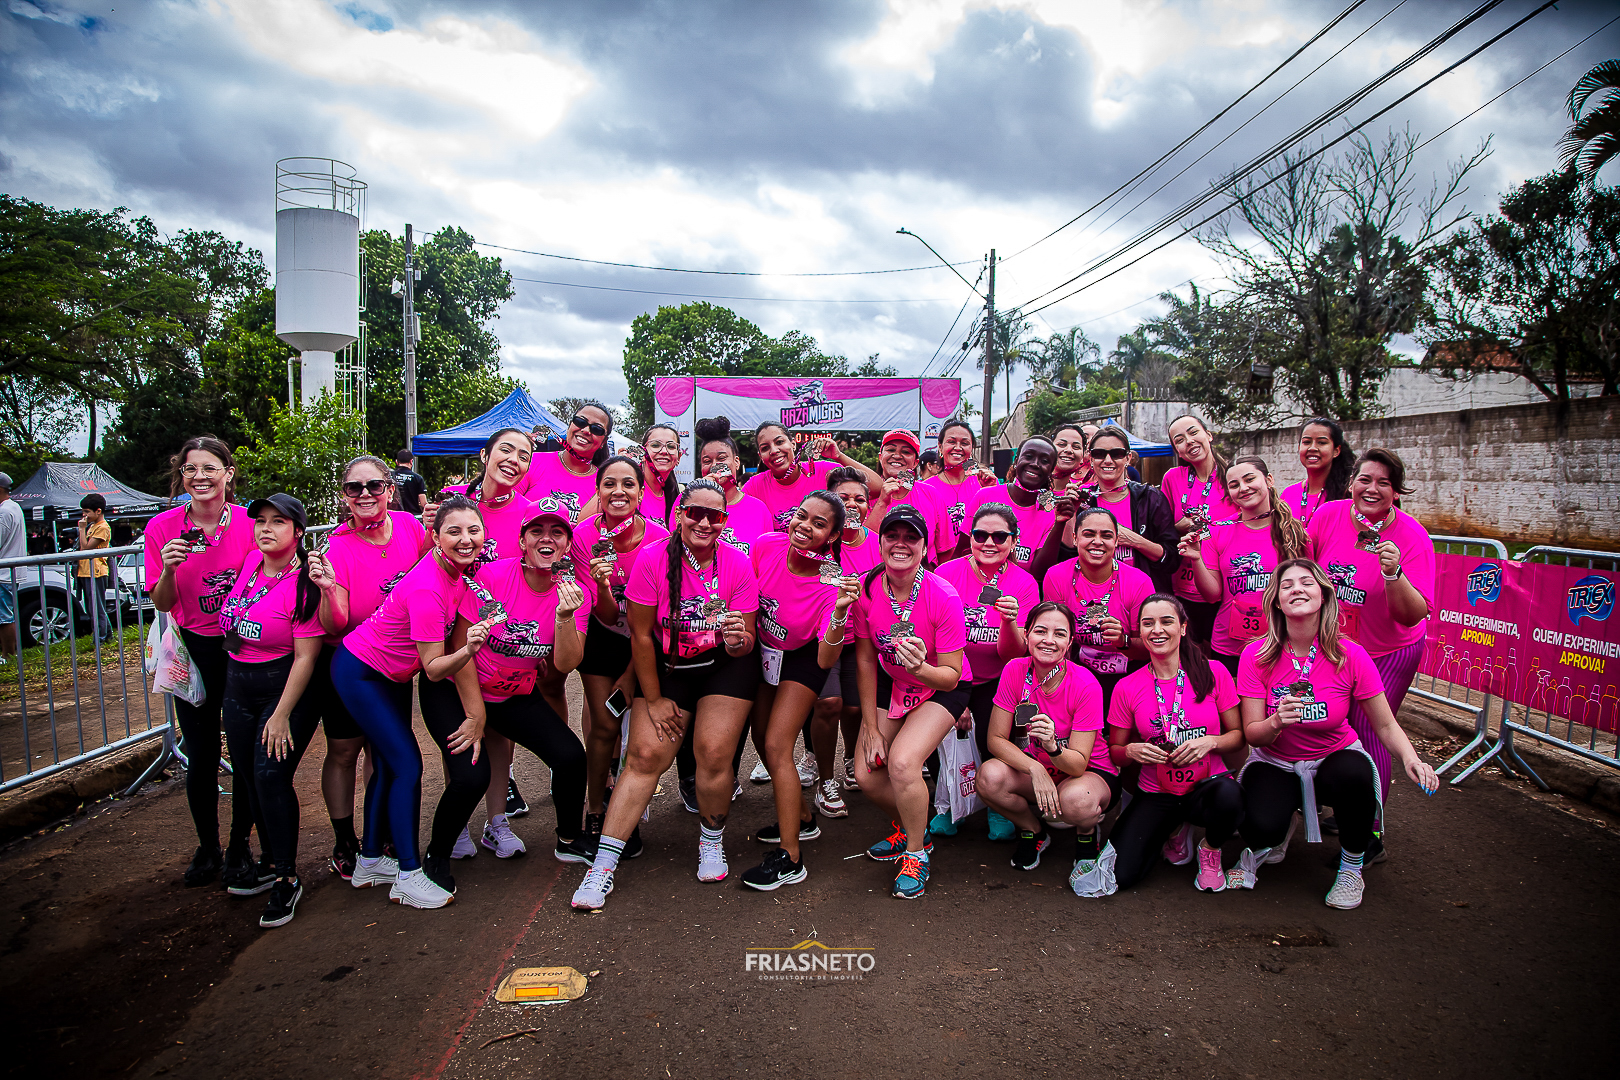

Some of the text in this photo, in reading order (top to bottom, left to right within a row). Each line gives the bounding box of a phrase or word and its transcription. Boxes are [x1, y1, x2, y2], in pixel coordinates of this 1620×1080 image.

[1242, 617, 1260, 631] 33
[1439, 609, 1521, 640] QUEM EXPERIMENTA,
[1460, 628, 1495, 647] APROVA!
[1532, 627, 1562, 646] QUEM
[1559, 651, 1606, 674] APROVA!
[492, 681, 521, 693] 241
[1165, 769, 1195, 783] 192
